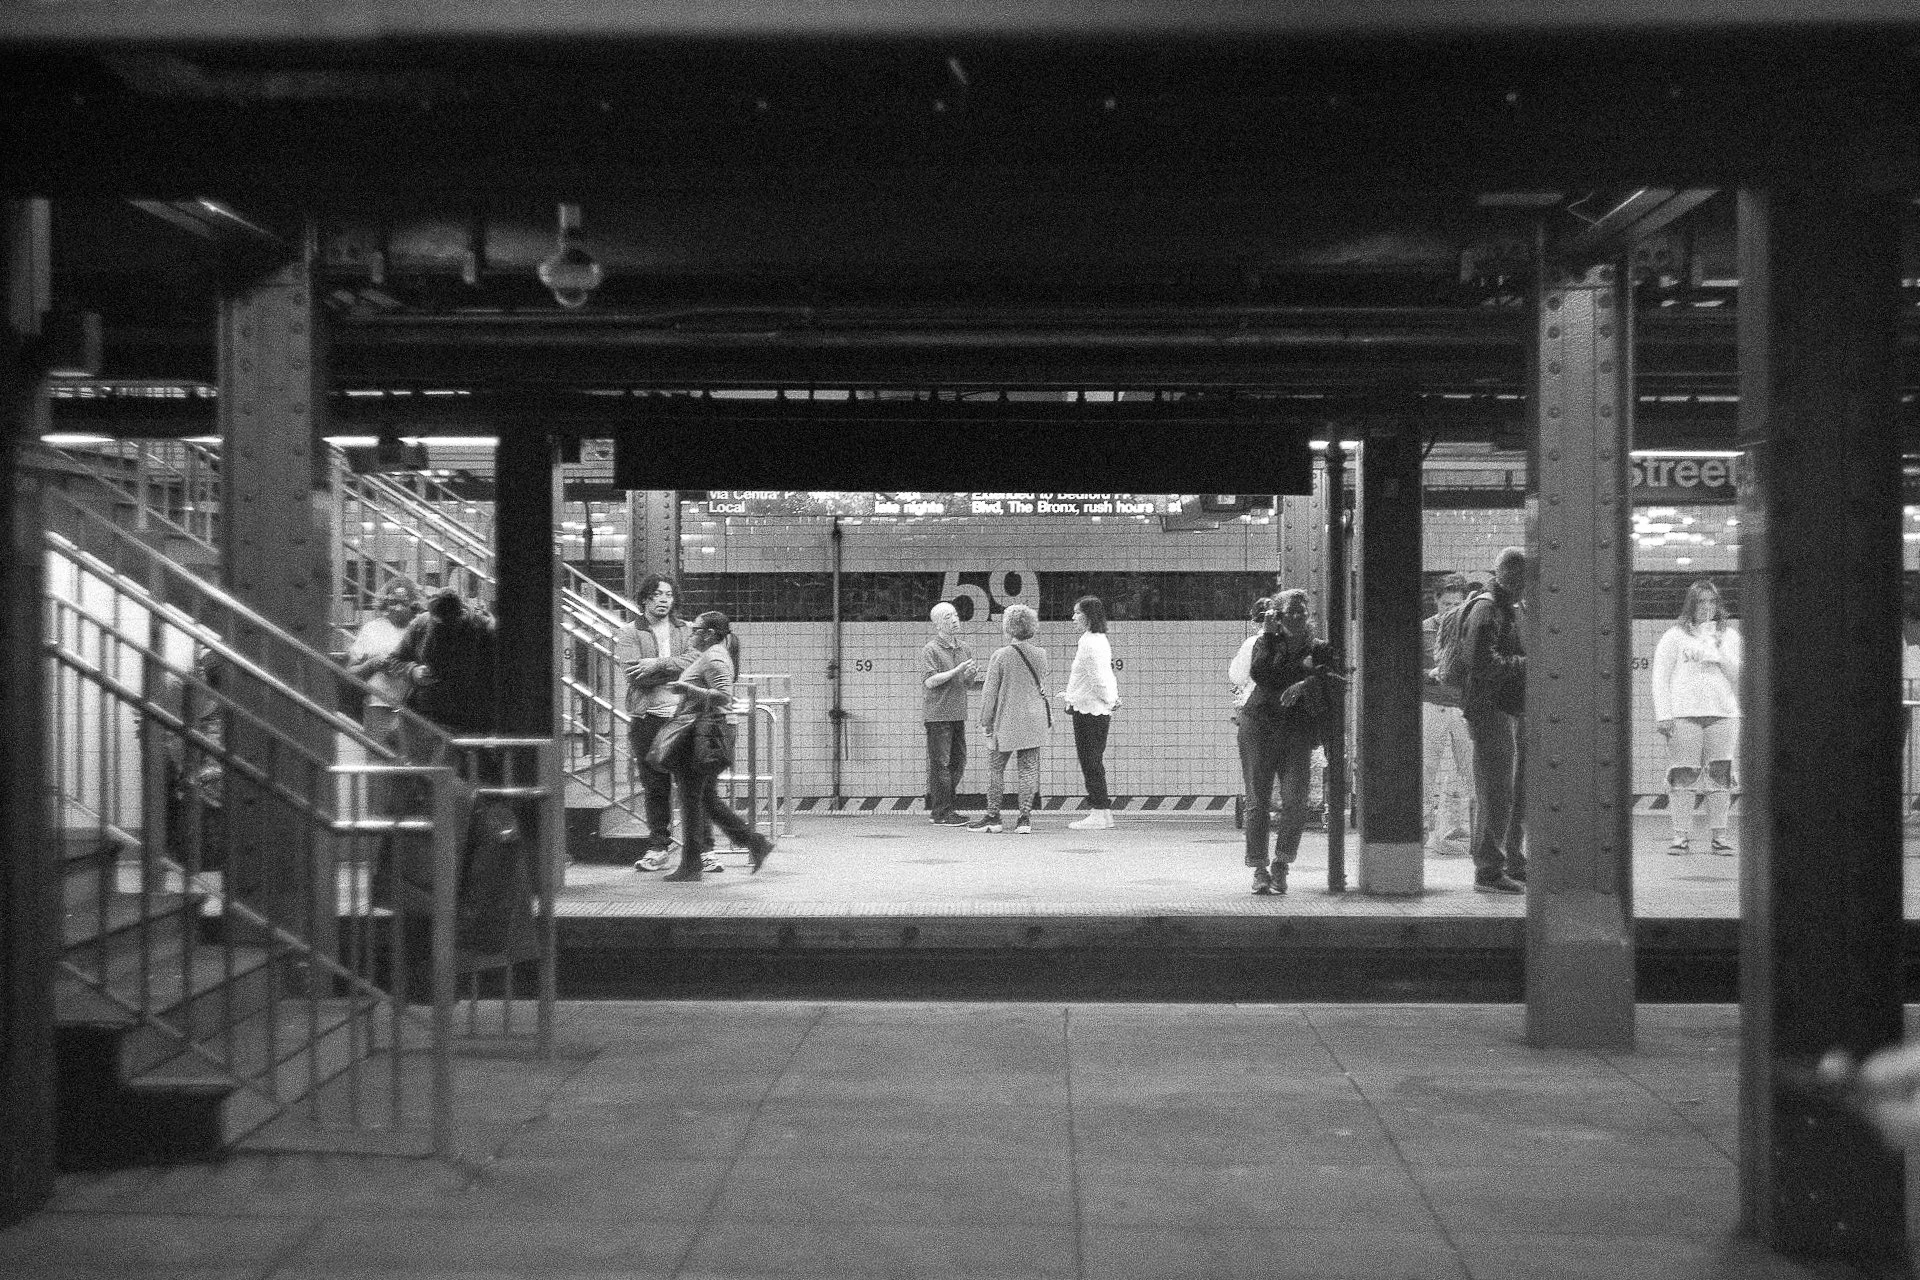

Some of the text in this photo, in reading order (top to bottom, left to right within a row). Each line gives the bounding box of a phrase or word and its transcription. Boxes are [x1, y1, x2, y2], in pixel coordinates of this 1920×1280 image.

[709, 500, 746, 513] Local
[875, 500, 944, 516] late nights
[972, 500, 1154, 515] Blvd, The Bronx, rush hours
[939, 570, 1040, 621] 59
[856, 659, 873, 672] 59
[1630, 657, 1648, 670] 59
